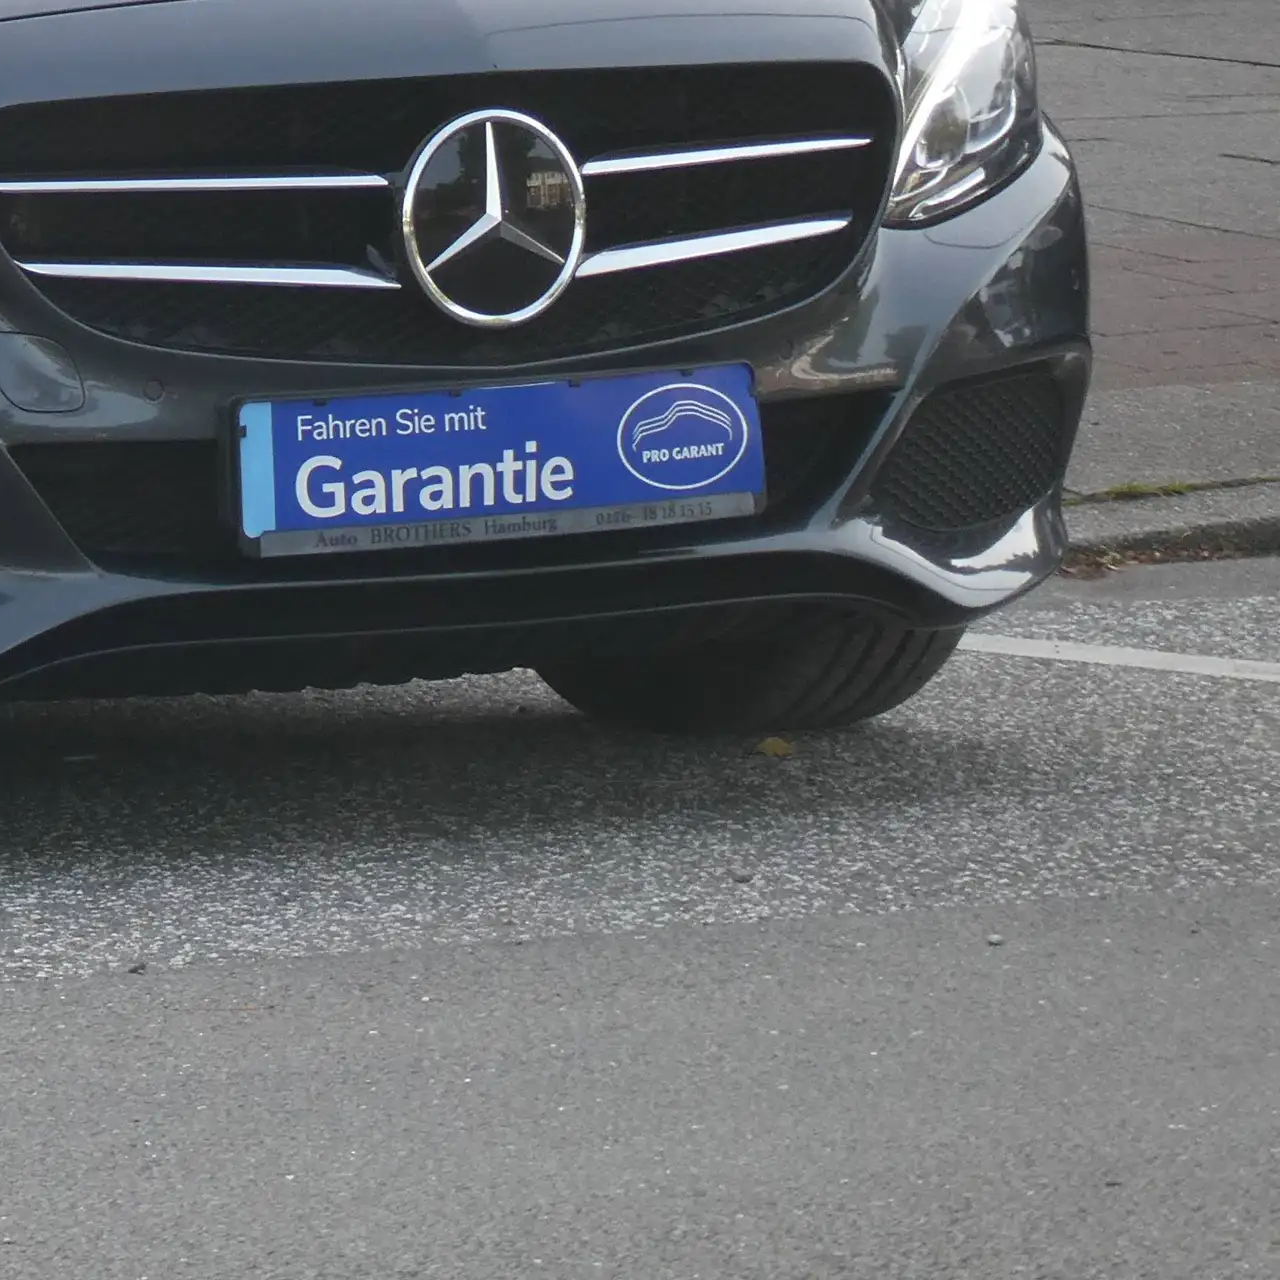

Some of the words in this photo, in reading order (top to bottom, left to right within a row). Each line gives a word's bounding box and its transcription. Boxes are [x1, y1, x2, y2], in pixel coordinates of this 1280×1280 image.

[296, 411, 387, 441] Fahren
[395, 408, 436, 437] Sie
[444, 405, 487, 433] mit
[642, 449, 670, 464] PRO
[672, 443, 725, 460] GARANT
[295, 440, 575, 519] Garantie
[314, 531, 358, 549] Auto
[370, 521, 472, 544] BROTHERS
[484, 516, 558, 535] Hamburg
